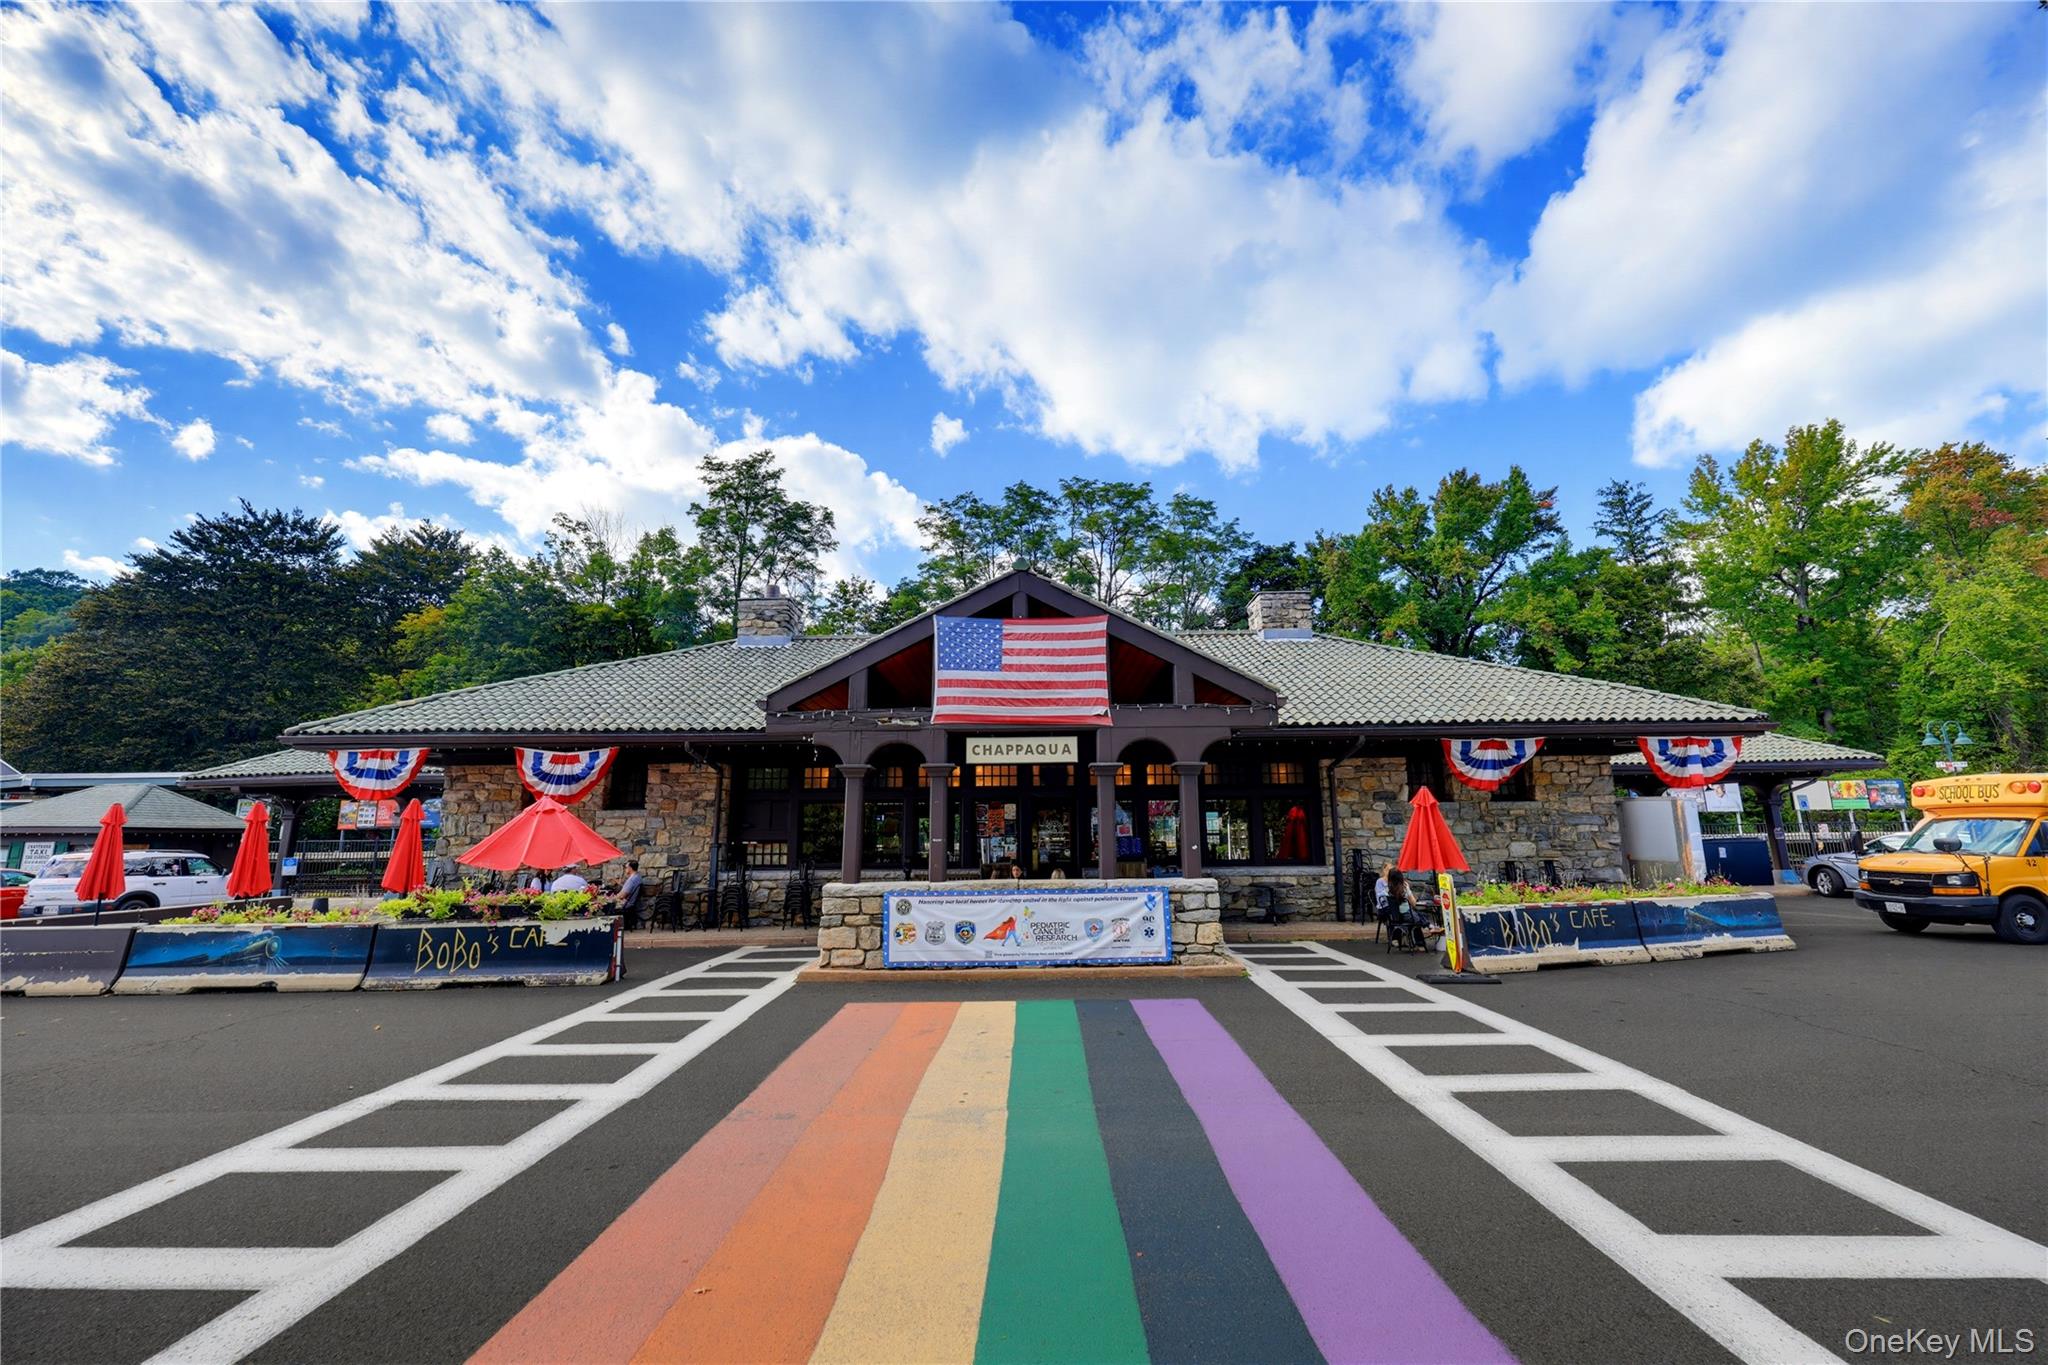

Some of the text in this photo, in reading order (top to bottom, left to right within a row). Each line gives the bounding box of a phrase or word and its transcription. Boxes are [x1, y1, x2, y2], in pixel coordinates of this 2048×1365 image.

[971, 743, 1072, 756] CHAPPAQUA
[1938, 783, 2000, 801] SCHOOL BUS
